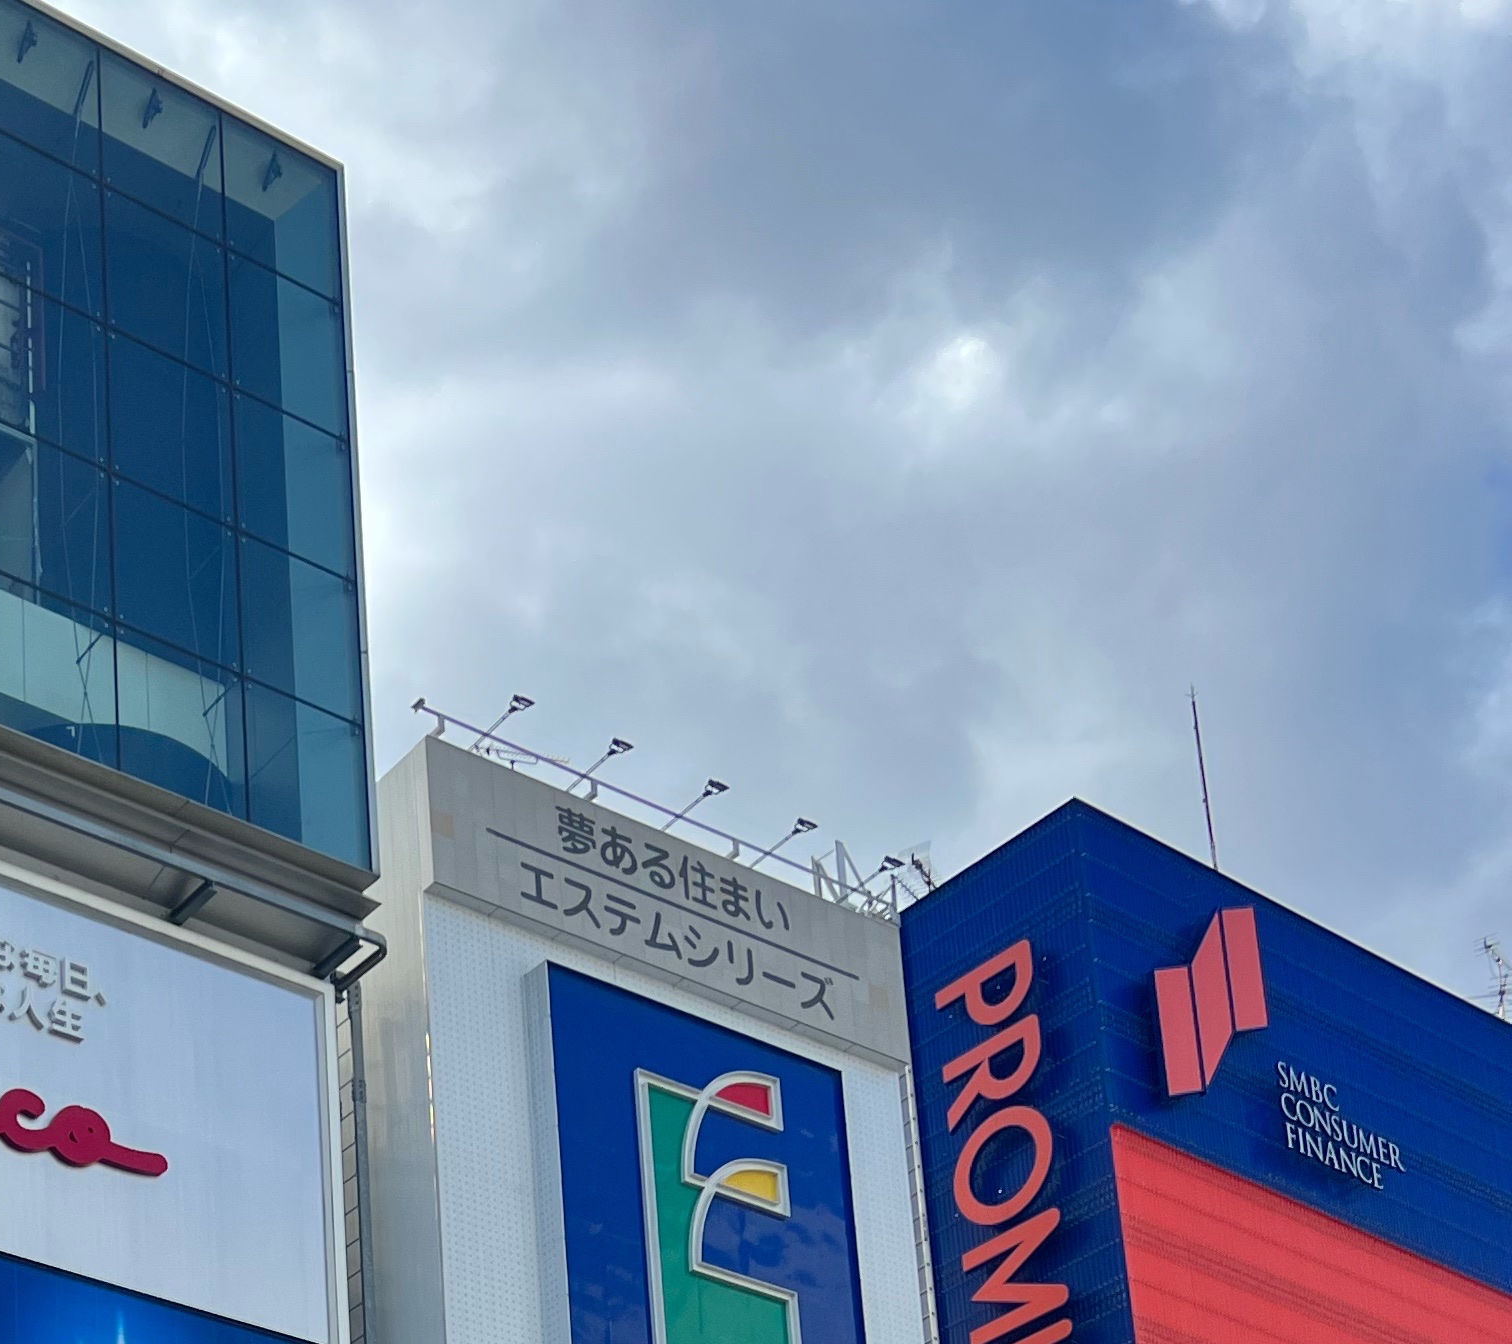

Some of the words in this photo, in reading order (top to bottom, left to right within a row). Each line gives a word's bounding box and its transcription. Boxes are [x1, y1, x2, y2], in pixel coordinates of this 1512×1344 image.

[555, 806, 790, 932] 夢ある住まい
[520, 861, 835, 1021] エステムシリーズ
[1277, 1061, 1339, 1112] SMBC
[1281, 1092, 1407, 1172] CONSUMER
[1285, 1121, 1384, 1189] FINANCE
